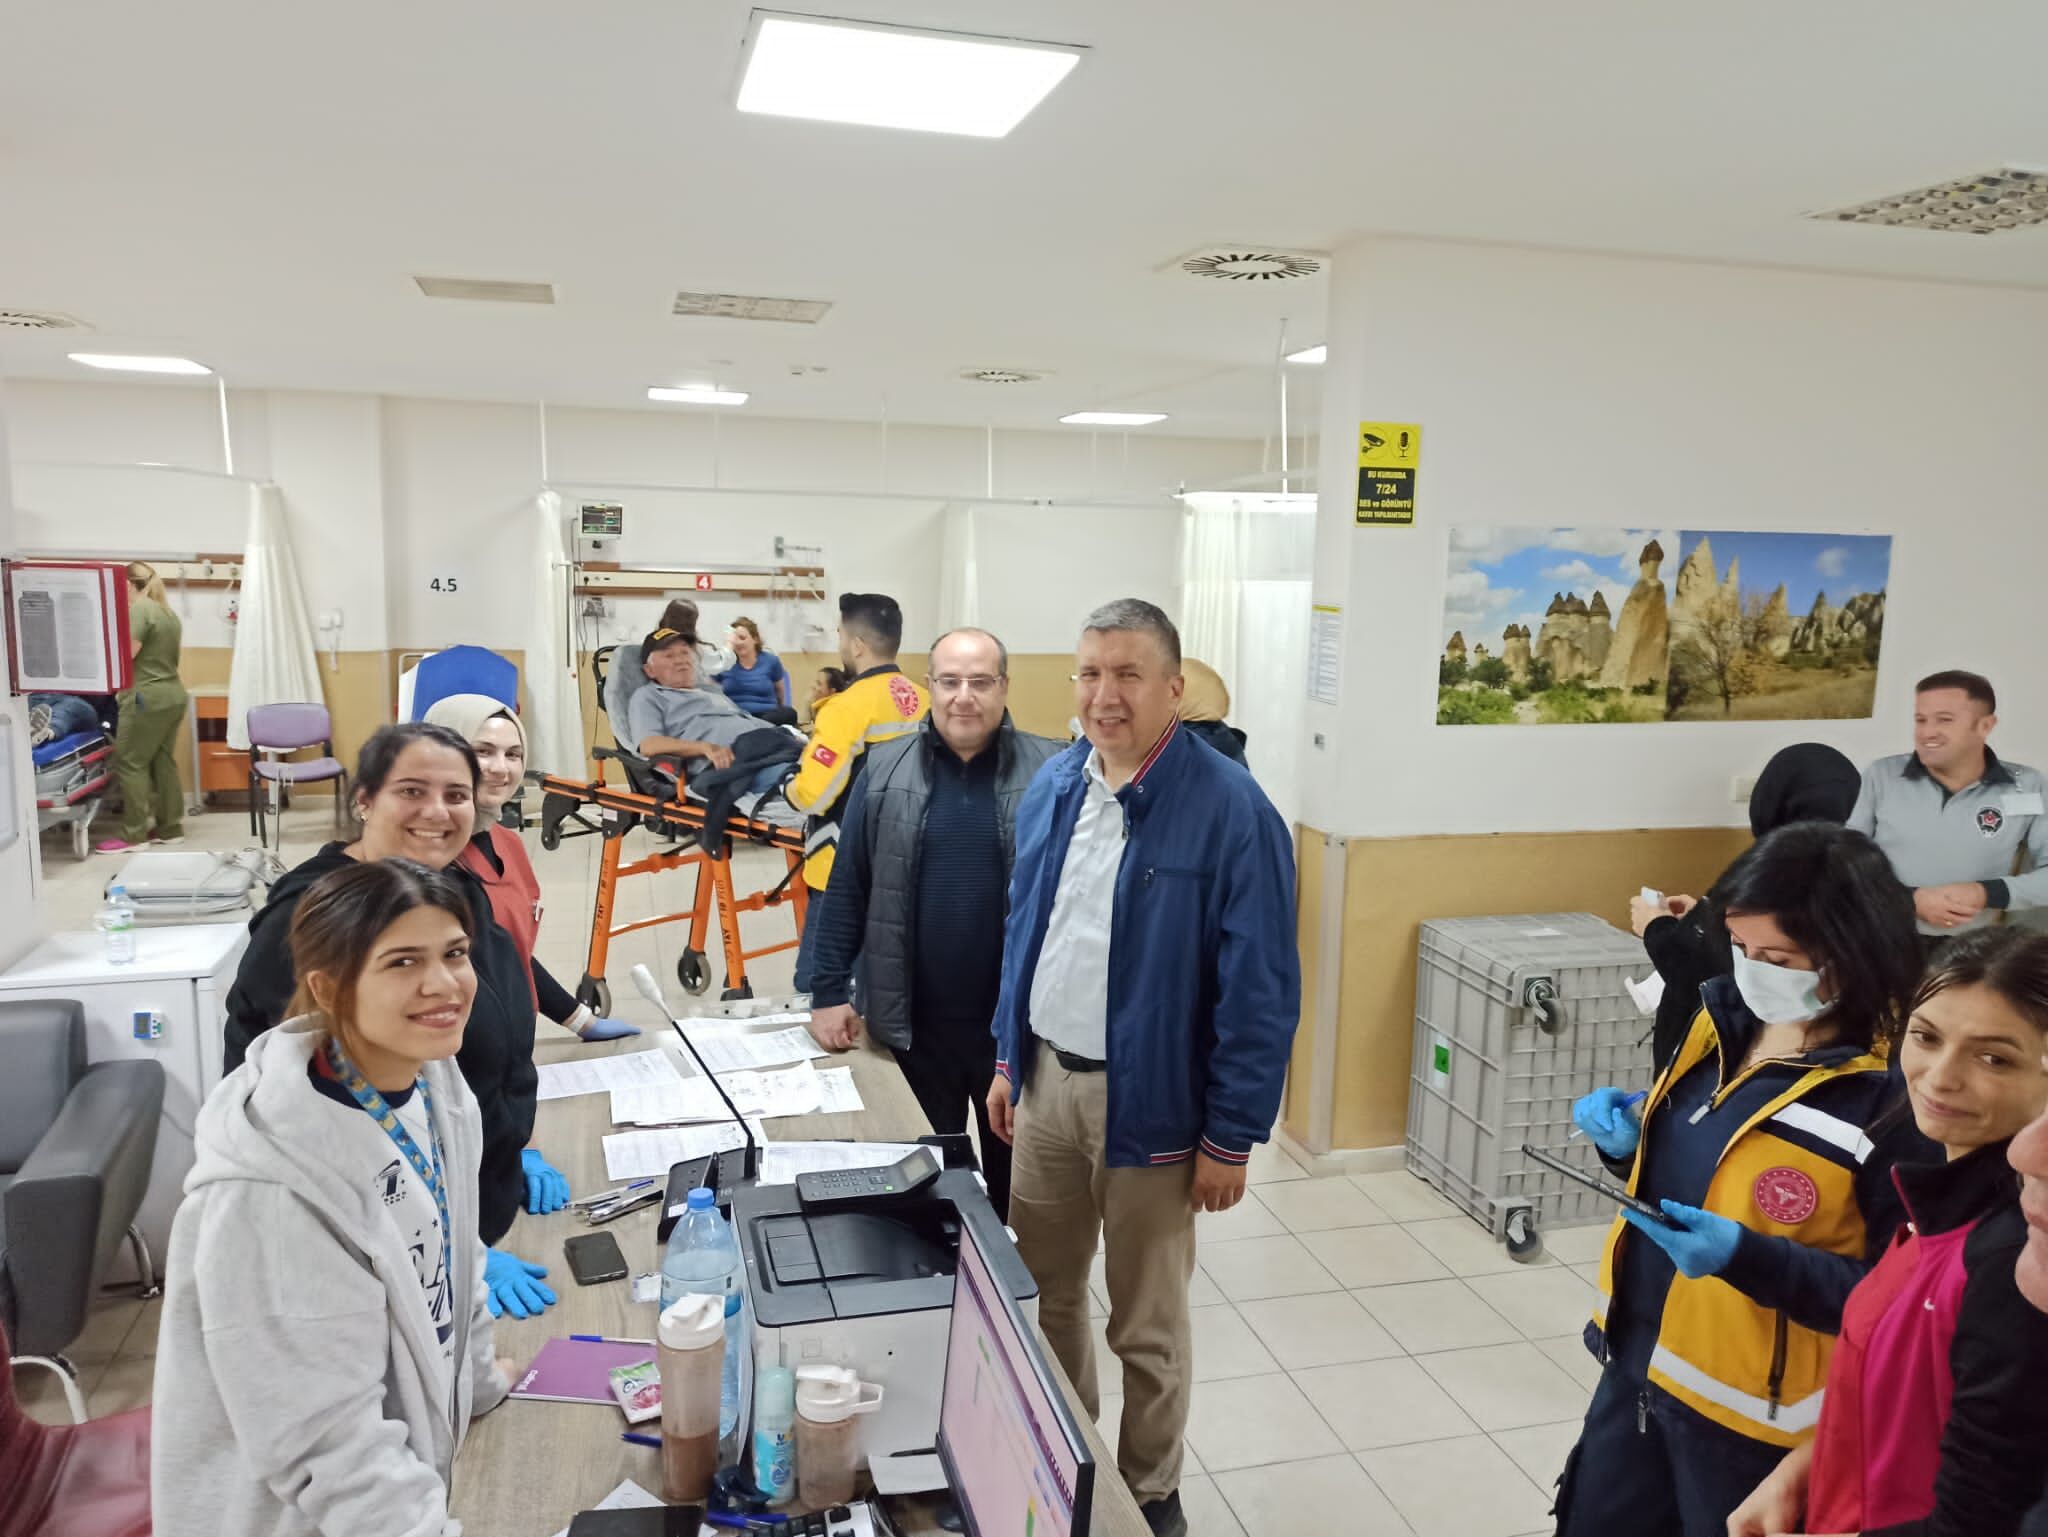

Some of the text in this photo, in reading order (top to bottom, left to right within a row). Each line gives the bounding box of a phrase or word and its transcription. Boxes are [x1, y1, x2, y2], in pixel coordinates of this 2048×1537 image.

[1376, 483, 1397, 495] 7/24
[430, 578, 457, 592] 4.5
[699, 575, 710, 590] 4
